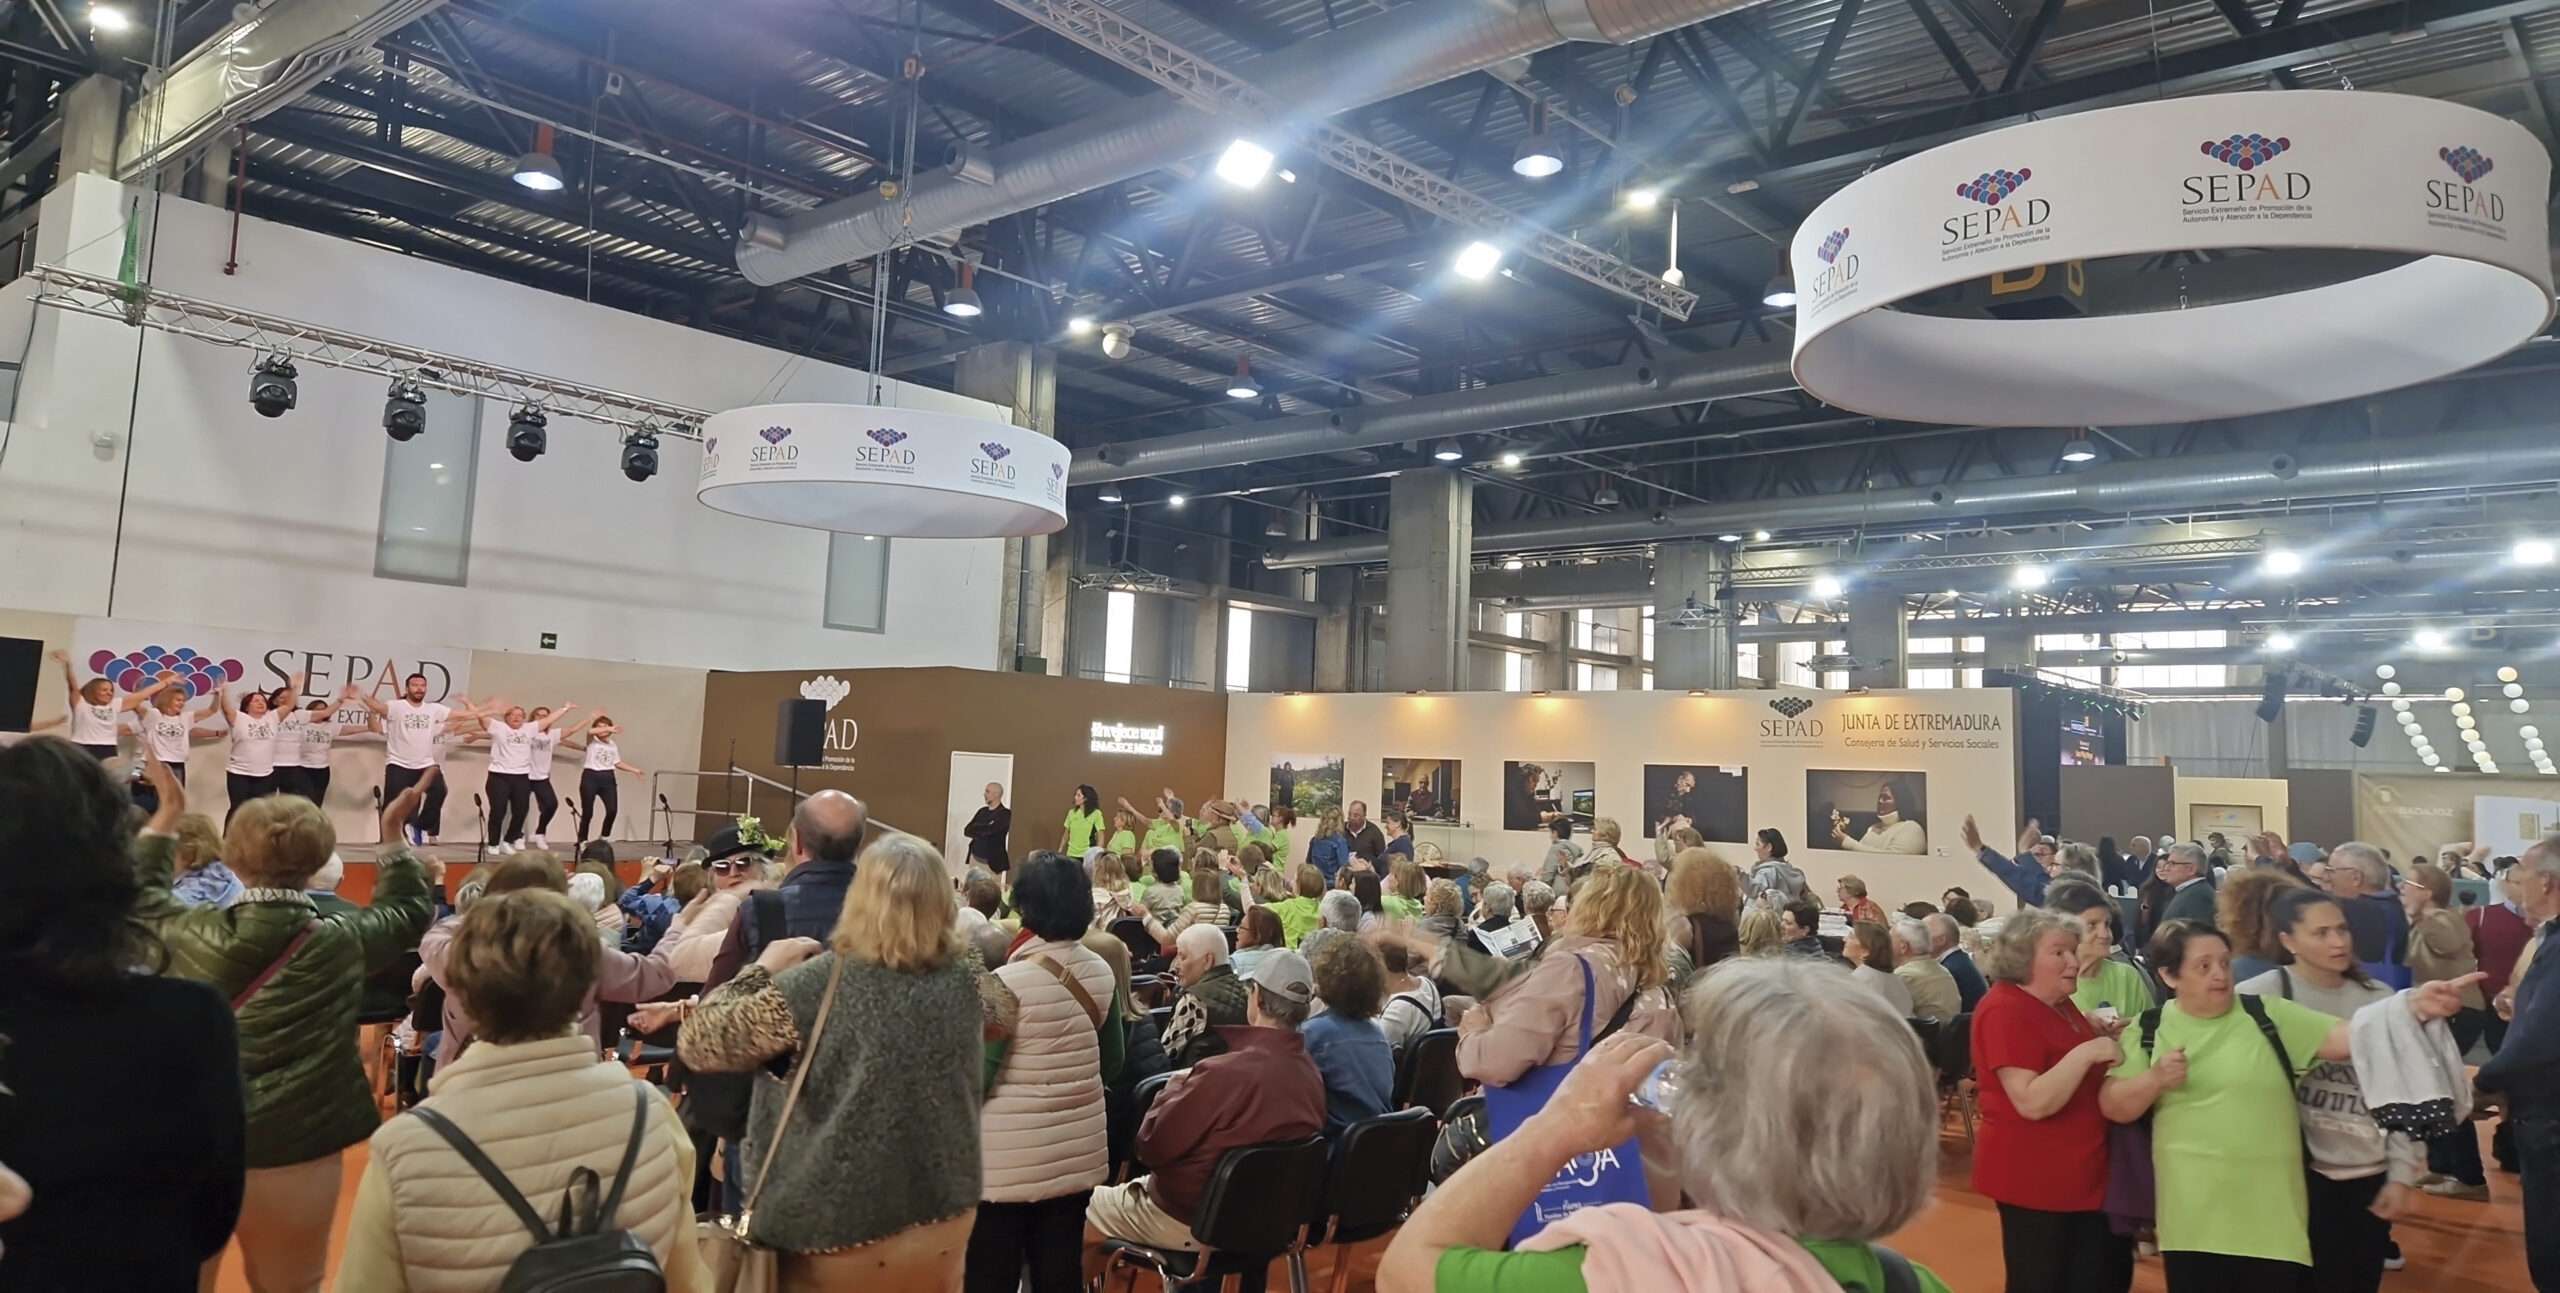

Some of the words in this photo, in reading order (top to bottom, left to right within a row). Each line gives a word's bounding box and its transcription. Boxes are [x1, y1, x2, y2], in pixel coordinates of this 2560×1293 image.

[2182, 172, 2311, 205] SEPAD
[2426, 179, 2504, 222] SEPAD
[1942, 198, 2050, 246] SEPAD
[1812, 253, 1859, 303] SEPAD
[750, 445, 799, 462] SEPAD
[855, 446, 916, 465] SEPAD
[970, 458, 1016, 480] SEPAD
[258, 648, 451, 704] SEPAD
[1759, 719, 1824, 738] SEPAD
[1842, 713, 1881, 733] JUNTA
[1885, 713, 1899, 731] DE
[1904, 713, 2001, 731] EXTREMADURA
[1887, 738, 1897, 747] de
[1899, 737, 1919, 748] Salud
[1928, 738, 1963, 749] Servicios
[1967, 738, 1999, 749] Sociales
